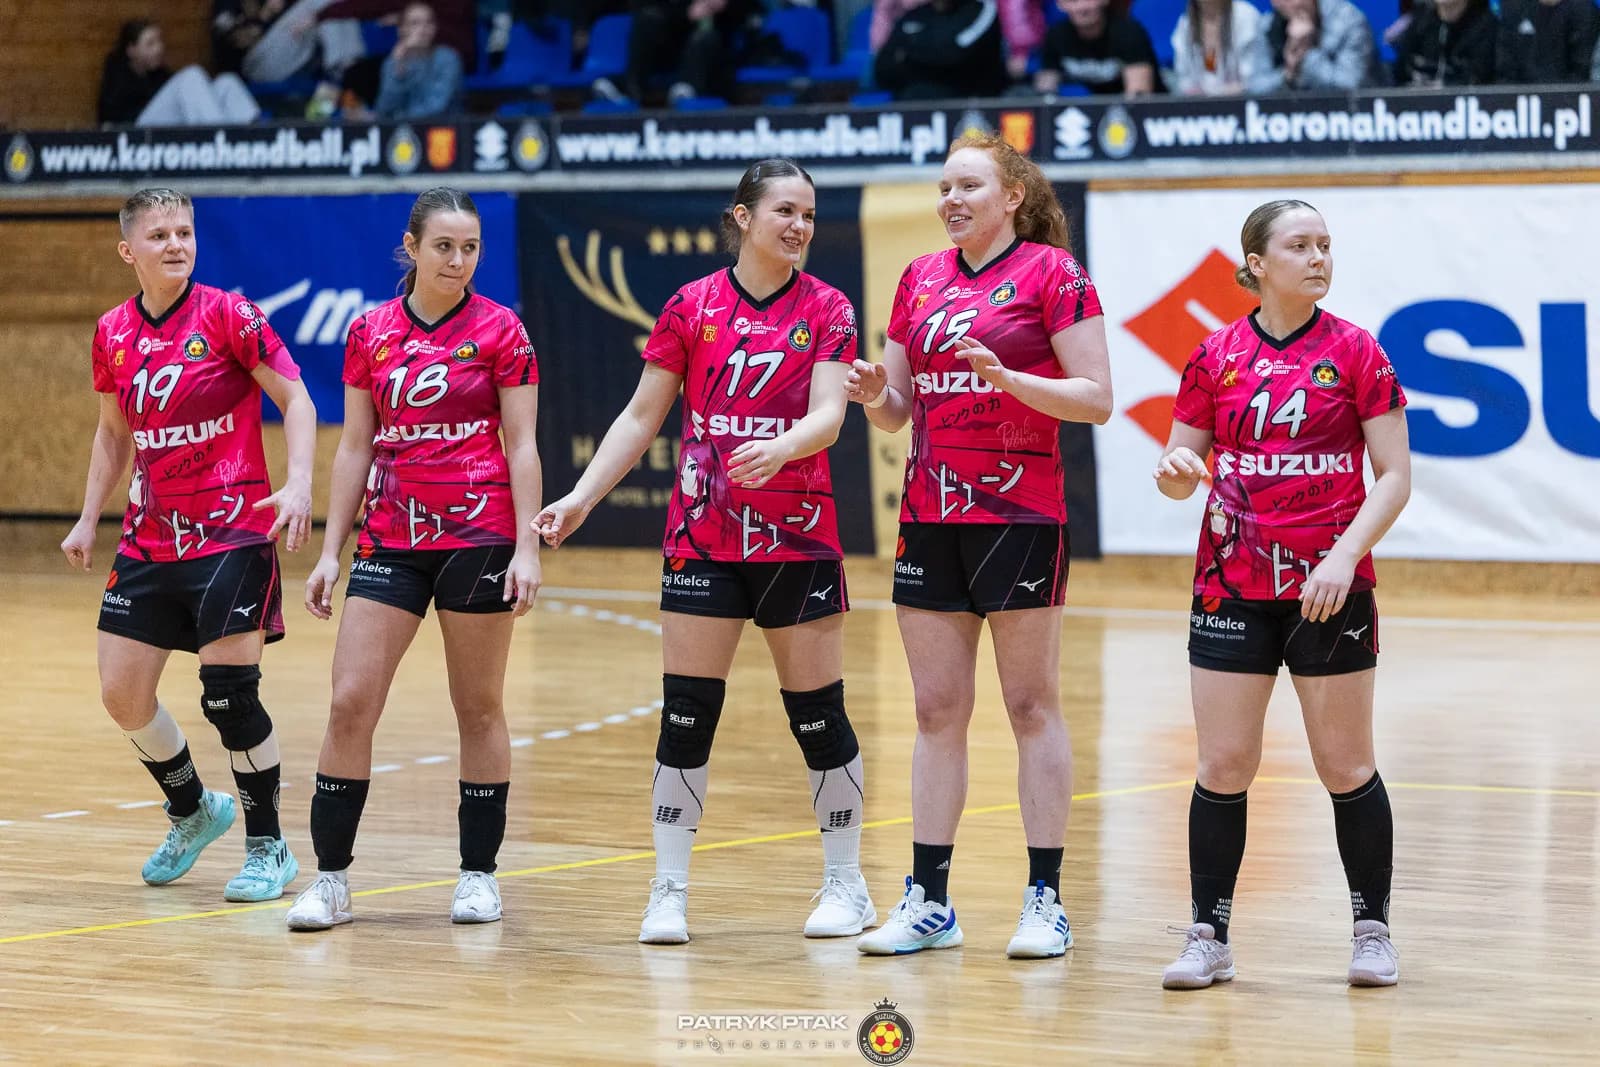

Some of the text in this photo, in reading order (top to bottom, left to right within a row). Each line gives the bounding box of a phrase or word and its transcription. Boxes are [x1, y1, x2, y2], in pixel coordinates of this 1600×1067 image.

[558, 111, 947, 165] www.koronahandball.pl
[1145, 95, 1591, 150] www.koronahandball.pl
[41, 127, 380, 177] www.koronahandball.pl
[922, 309, 979, 354] 15
[132, 363, 184, 414] 19
[388, 363, 449, 409] 18
[727, 350, 785, 398] 17
[1250, 389, 1307, 440] 14
[132, 413, 235, 450] SUZUKI
[1239, 452, 1354, 477] SUZUKI
[358, 560, 392, 575] Kielce
[673, 573, 711, 587] Kielce
[896, 561, 924, 576] Kielce
[1206, 615, 1246, 630] Kielce
[669, 713, 696, 725] SELECT
[799, 719, 826, 732] SELECT
[656, 815, 678, 824] cep
[829, 820, 850, 828] cep
